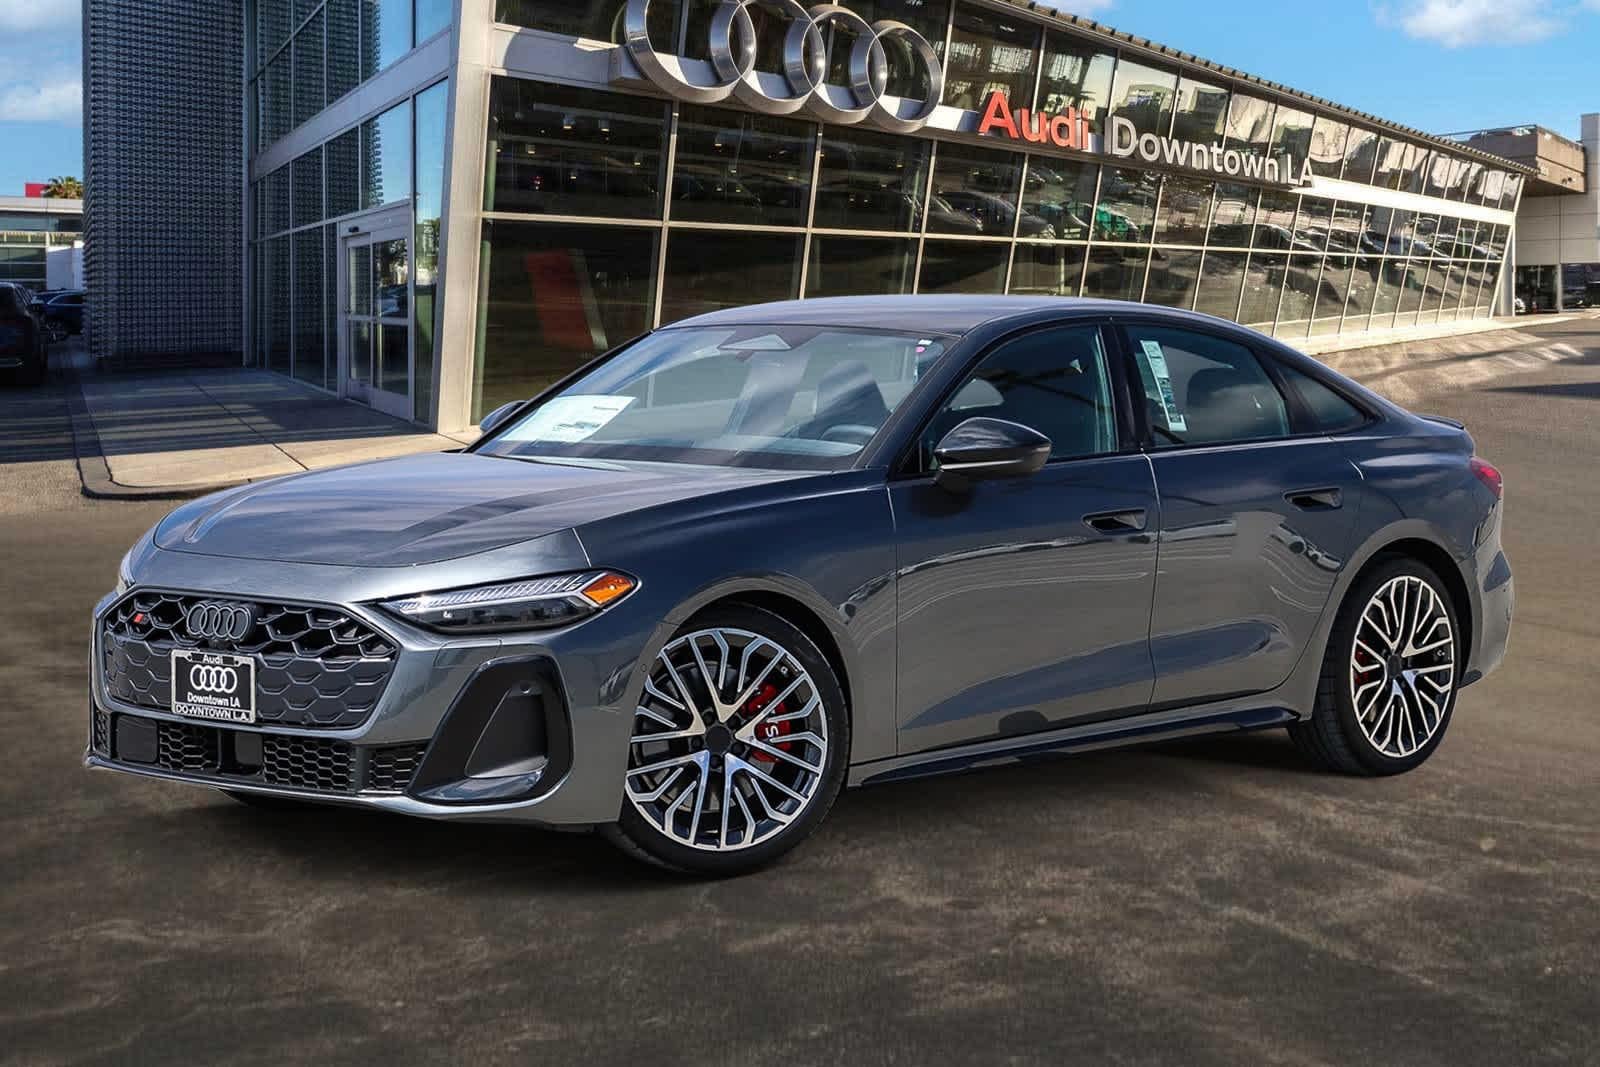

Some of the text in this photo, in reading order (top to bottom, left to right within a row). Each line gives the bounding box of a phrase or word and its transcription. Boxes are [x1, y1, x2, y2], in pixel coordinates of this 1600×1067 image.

[978, 91, 1316, 189] Audi Downtown LA
[202, 654, 223, 665] Audi
[187, 692, 241, 708] Downtown LA
[176, 705, 231, 719] DOWNTOWN
